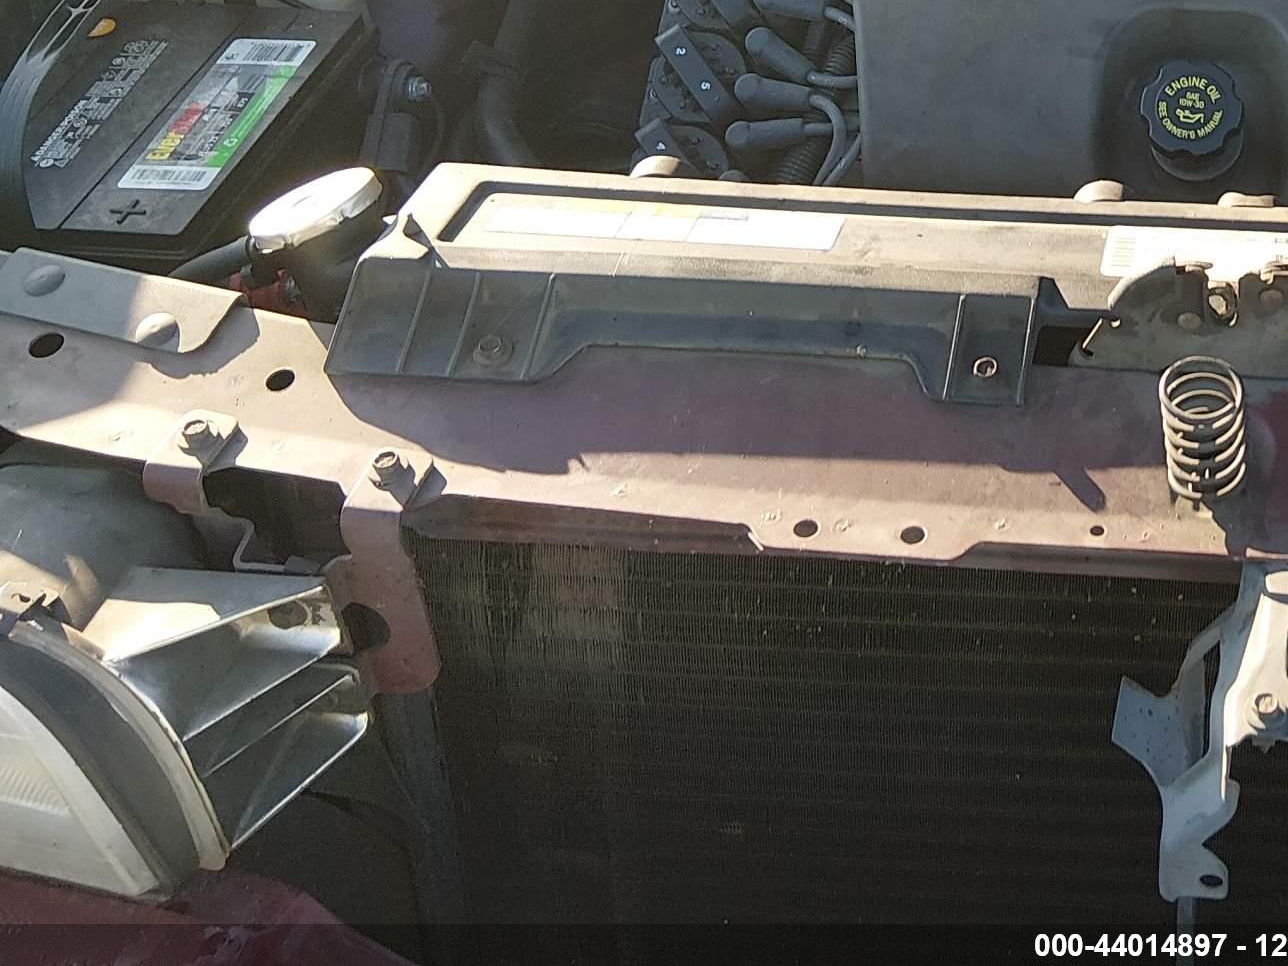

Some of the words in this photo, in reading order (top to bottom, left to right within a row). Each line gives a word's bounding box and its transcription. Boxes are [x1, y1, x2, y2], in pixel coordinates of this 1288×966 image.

[675, 46, 687, 56] 2
[700, 81, 711, 90] 5
[1164, 75, 1208, 96] ENGINE
[1206, 84, 1222, 104] OIL
[1158, 100, 1168, 119] SEE
[1196, 109, 1223, 138] MANUAL
[655, 141, 666, 151] 4
